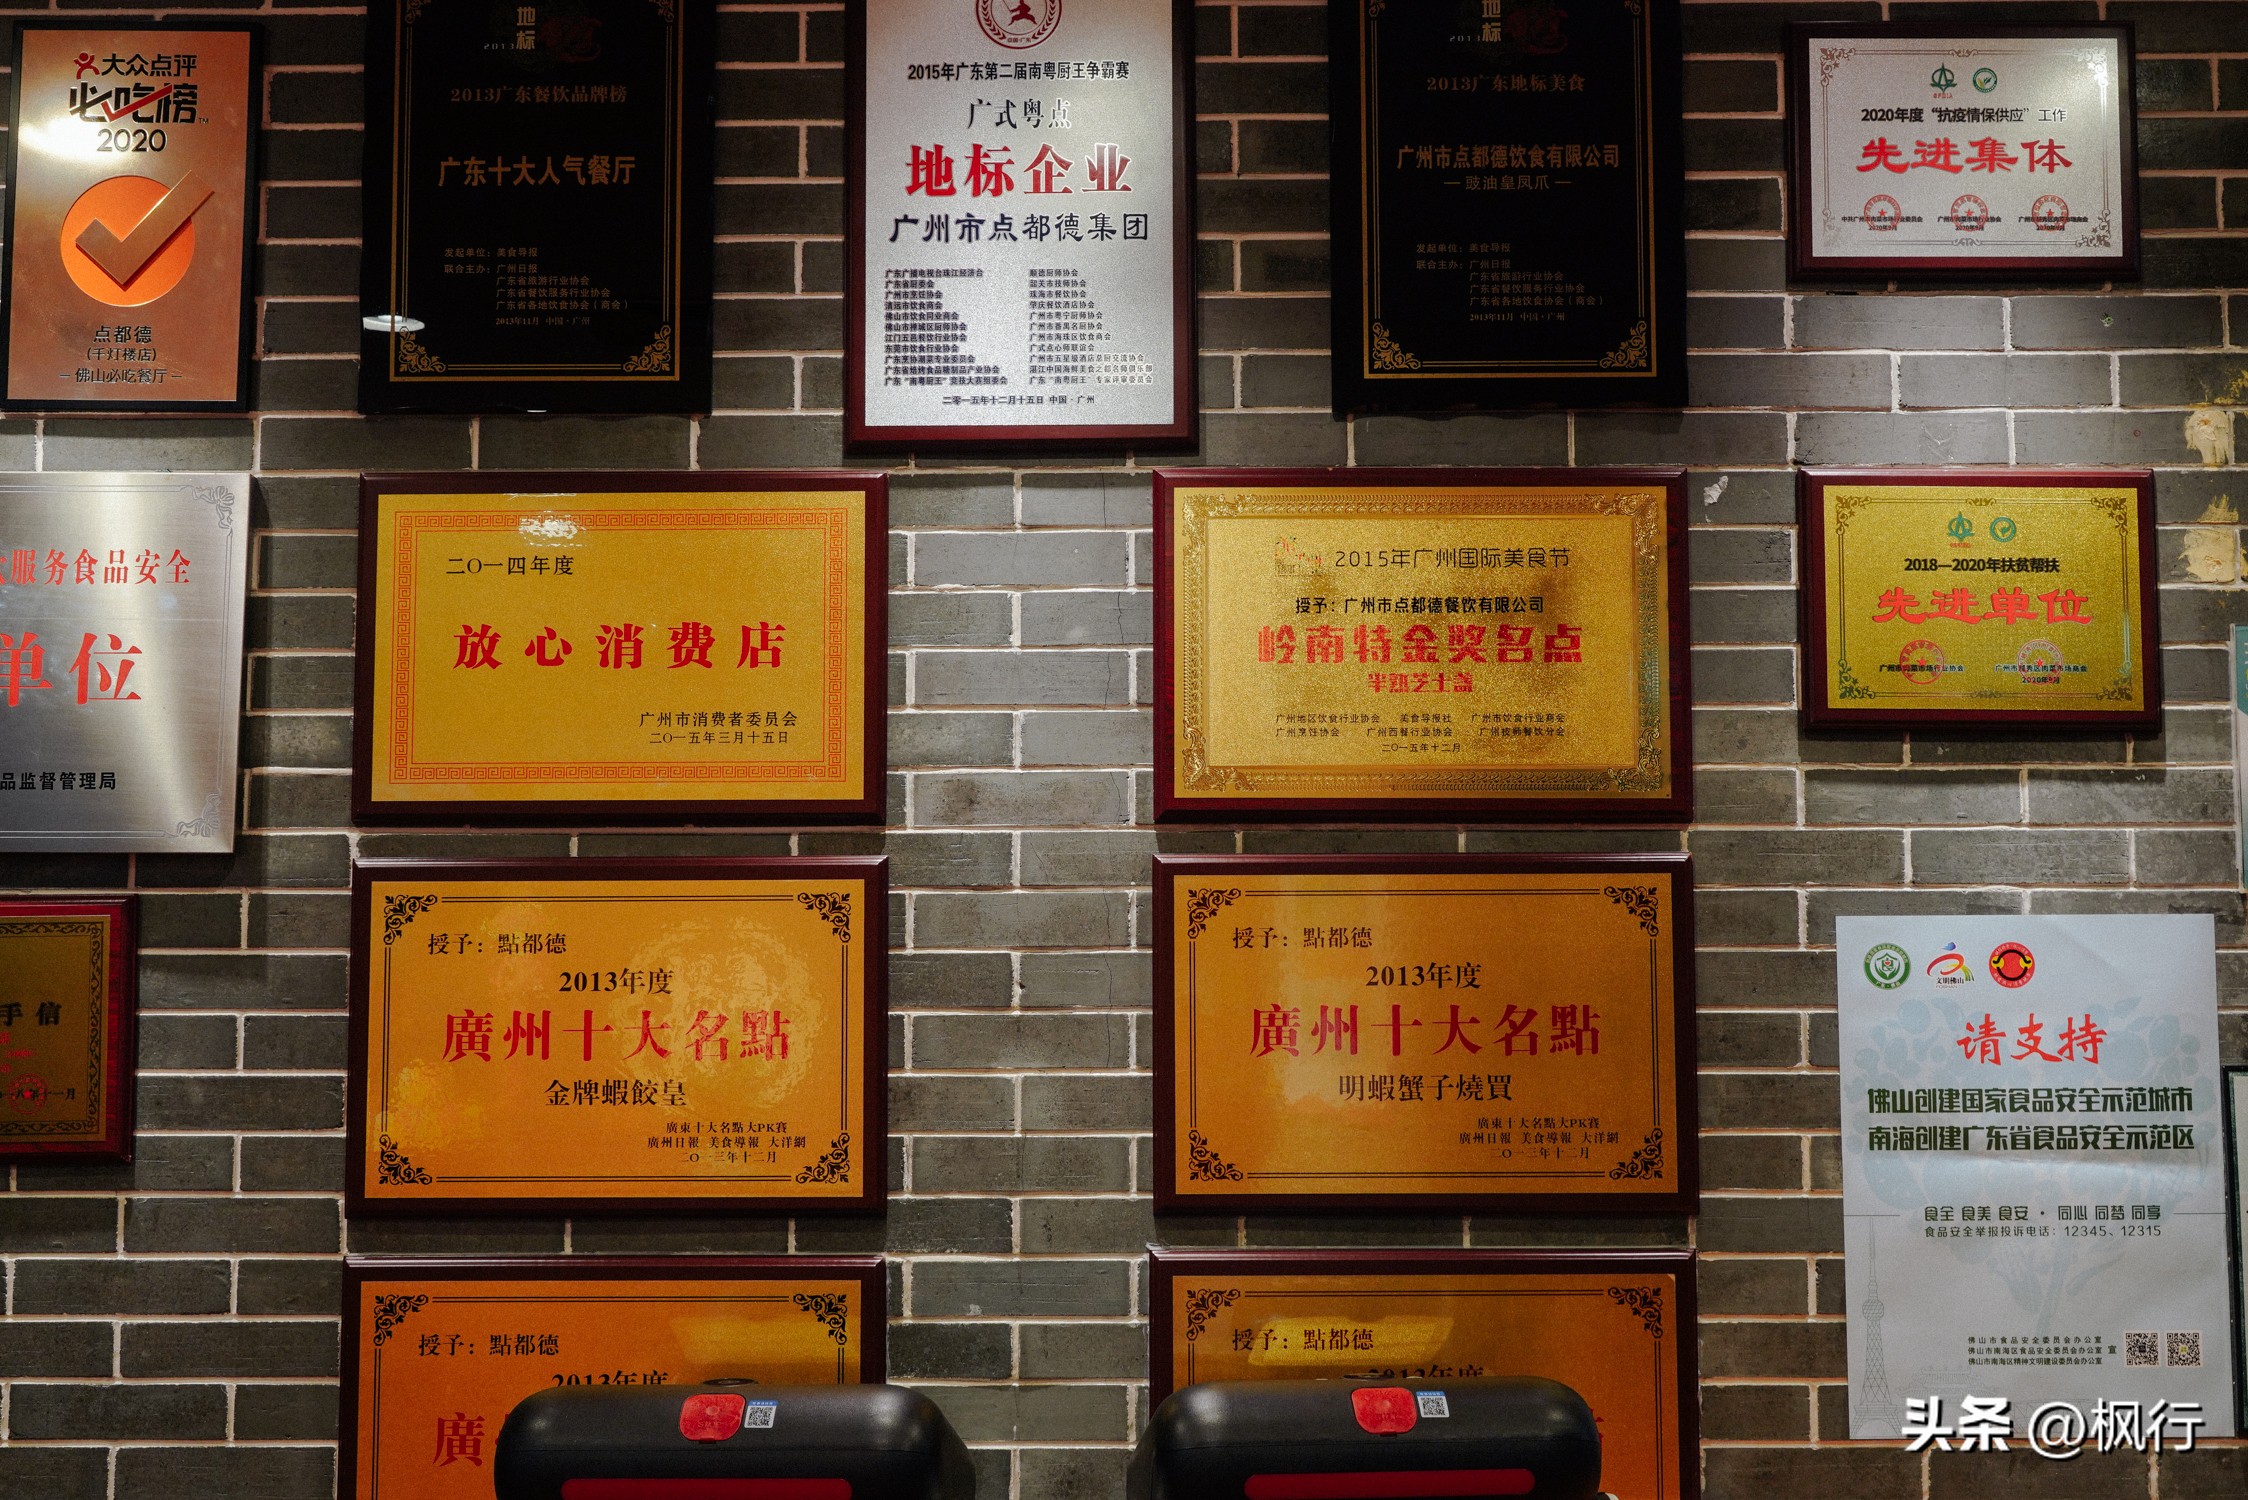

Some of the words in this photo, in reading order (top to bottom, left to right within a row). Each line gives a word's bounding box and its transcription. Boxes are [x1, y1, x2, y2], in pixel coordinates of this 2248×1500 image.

[516, 6, 536, 50] 地标
[101, 53, 197, 77] 大众点评
[908, 61, 1130, 82] 2015年广东第二届南粤厨王争霸赛
[451, 85, 628, 104] 2013广东餐饮品牌榜
[1427, 74, 1587, 92] 2013广东地标美食
[69, 82, 198, 124] 必吃榜
[967, 98, 1072, 130] 广式粤点
[96, 128, 167, 152] 2020
[1397, 144, 1620, 169] 广州市点都德饮食有限公司
[1856, 136, 2074, 174] 先进集体
[438, 155, 636, 187] 广东十大人气餐厅
[905, 143, 1133, 198] 地标企业
[1465, 175, 1550, 191] 豉油皇凤爪
[889, 212, 1149, 243] 广州市点都德集团
[93, 325, 153, 344] 点都德
[75, 367, 168, 384] 佛山必吃餐厅
[1335, 547, 1571, 569] 2015年广州国际美食节
[1872, 587, 2093, 625] 先进单位
[452, 621, 787, 671] 放心消费店
[1257, 623, 1583, 665] 岭南特金奖名点
[639, 711, 798, 728] 广州市消费者委员会
[1, 772, 116, 790] 品监督管理局
[559, 968, 674, 996] 2013年度
[1365, 961, 1482, 990] 2013年度
[441, 1008, 792, 1063] 廣州十大名點
[1249, 1003, 1601, 1058] 廣州十大名點
[1957, 1012, 2108, 1066] 请支持
[544, 1079, 687, 1107] 金牌蝦餃皇
[1338, 1073, 1514, 1102] 明蝦蟹子燒買
[1867, 1086, 2193, 1114] 佛山创建国家食品安全示范城市
[647, 1135, 700, 1149] 廣州日報
[708, 1135, 760, 1149] 美食導報
[769, 1135, 807, 1149] 大洋網
[1459, 1131, 1512, 1145] 廣州日報
[1521, 1131, 1573, 1145] 美食導報
[1580, 1131, 1619, 1145] 大洋網
[1868, 1124, 2194, 1151] 南海创建广东省食品安全示范区
[1967, 1335, 2103, 1345] 佛山市食品安全委员会办公室
